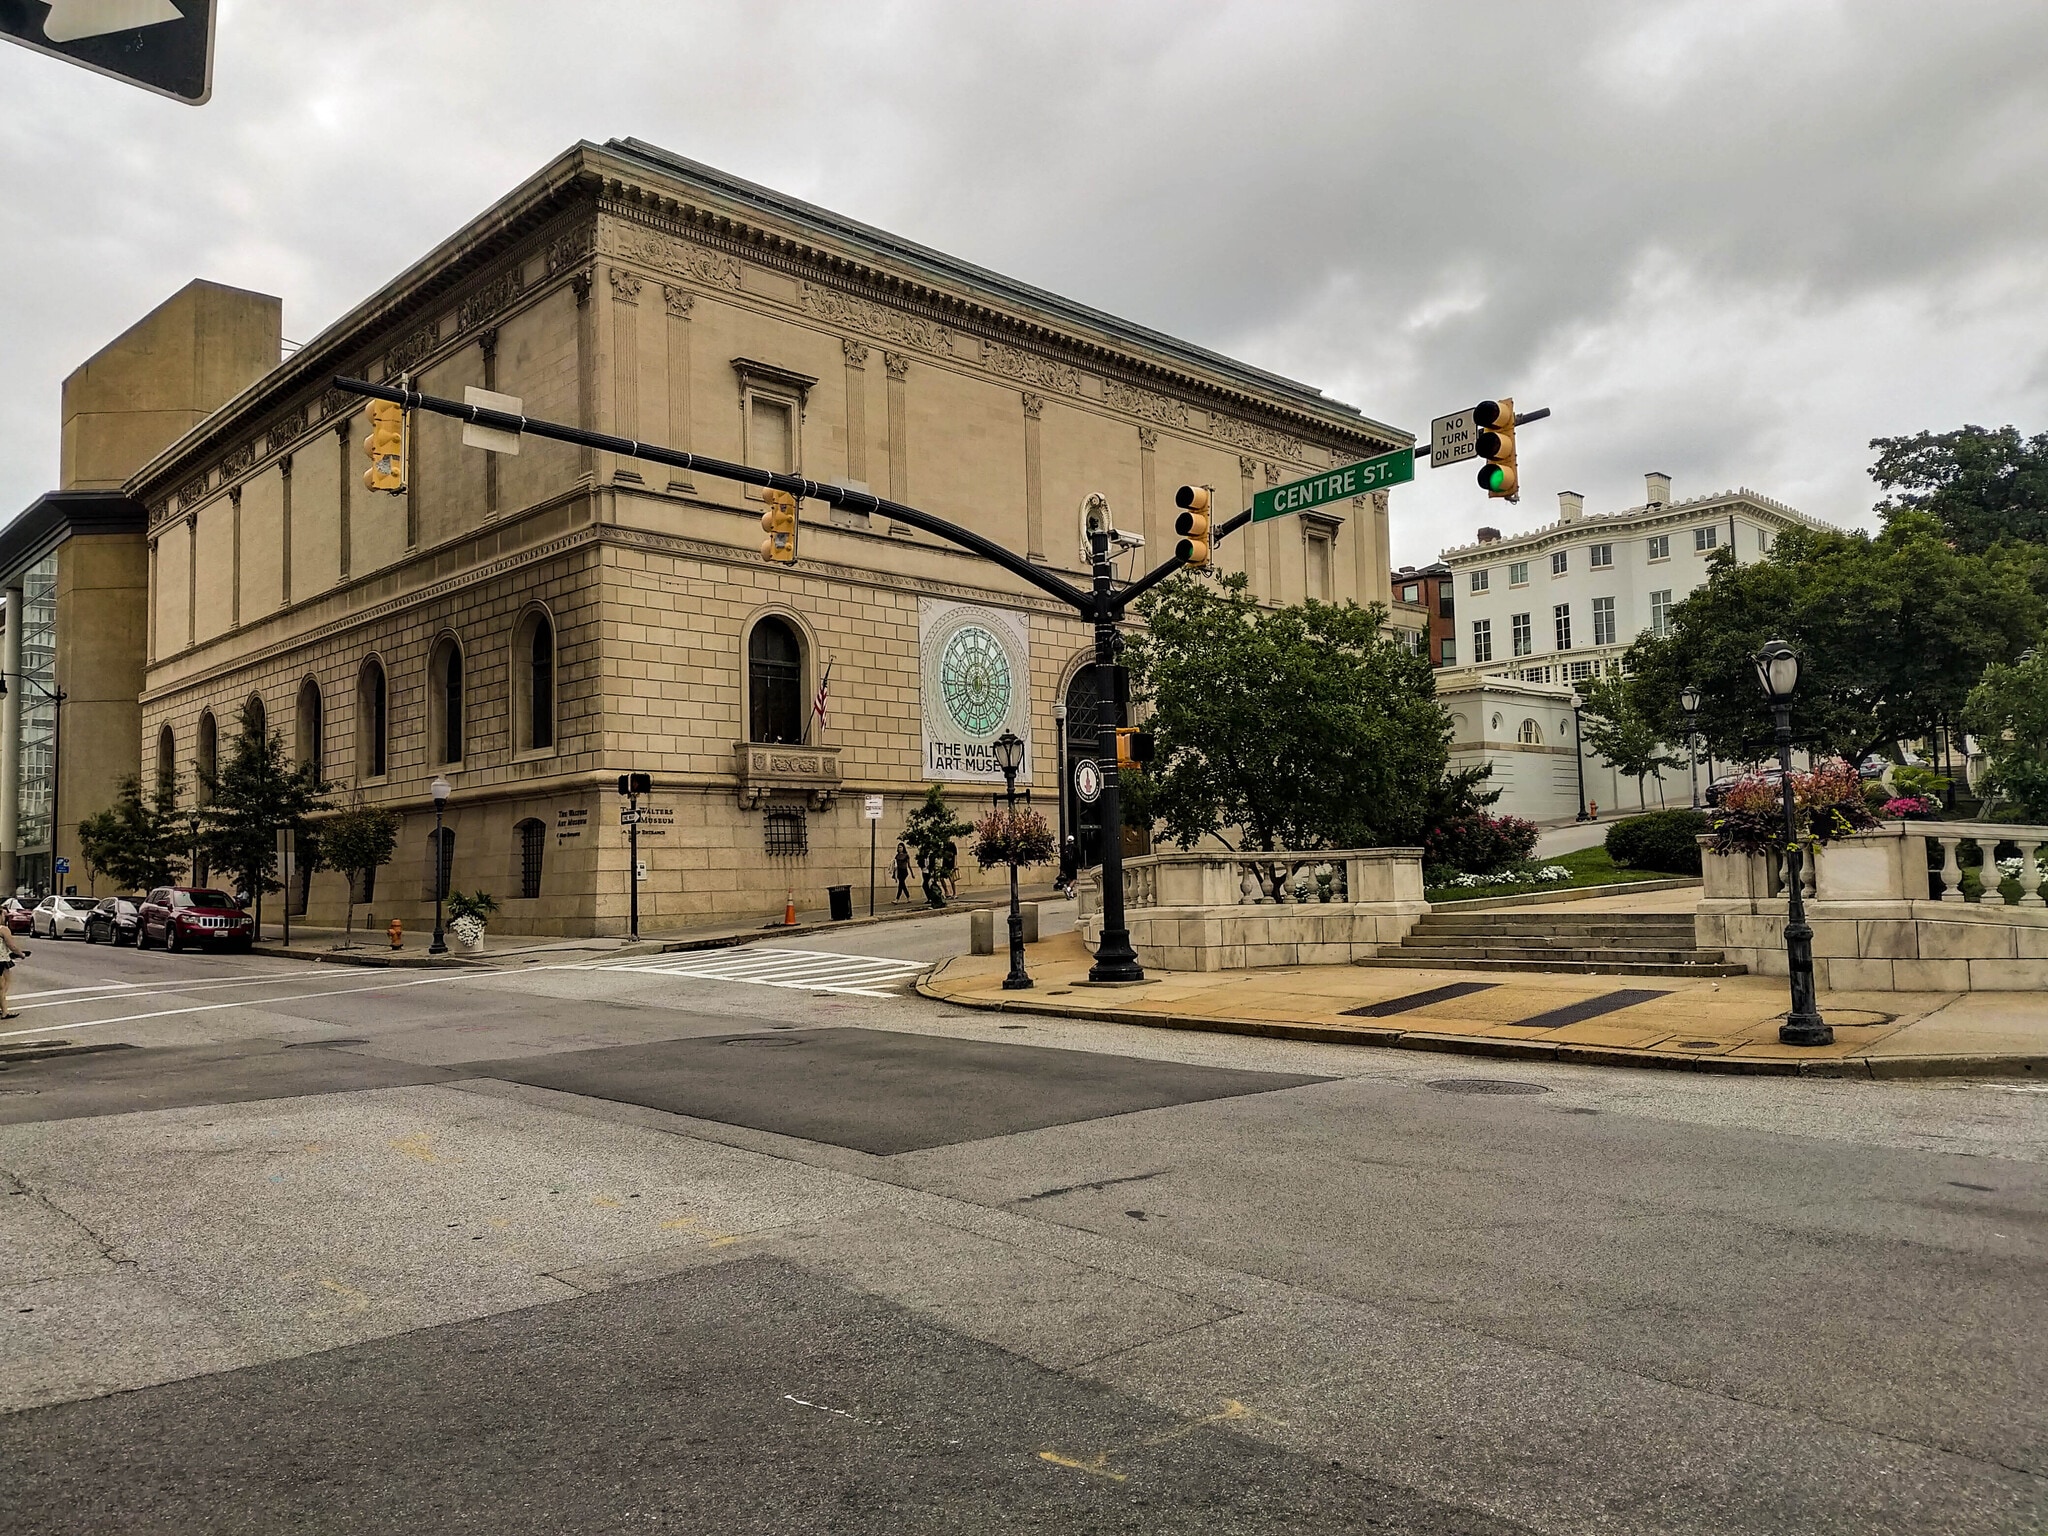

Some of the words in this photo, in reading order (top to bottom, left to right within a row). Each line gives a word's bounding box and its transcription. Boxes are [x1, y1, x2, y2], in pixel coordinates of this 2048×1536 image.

[1446, 418, 1463, 431] NO
[1441, 430, 1468, 446] TURN
[1435, 449, 1449, 461] ON
[1453, 442, 1474, 456] RED
[1274, 470, 1356, 511] CENTRE
[1364, 462, 1393, 484] ST.
[935, 742, 961, 756] THE
[964, 744, 996, 758] WALT
[936, 757, 961, 770] ART
[966, 758, 1019, 773] MUSE
